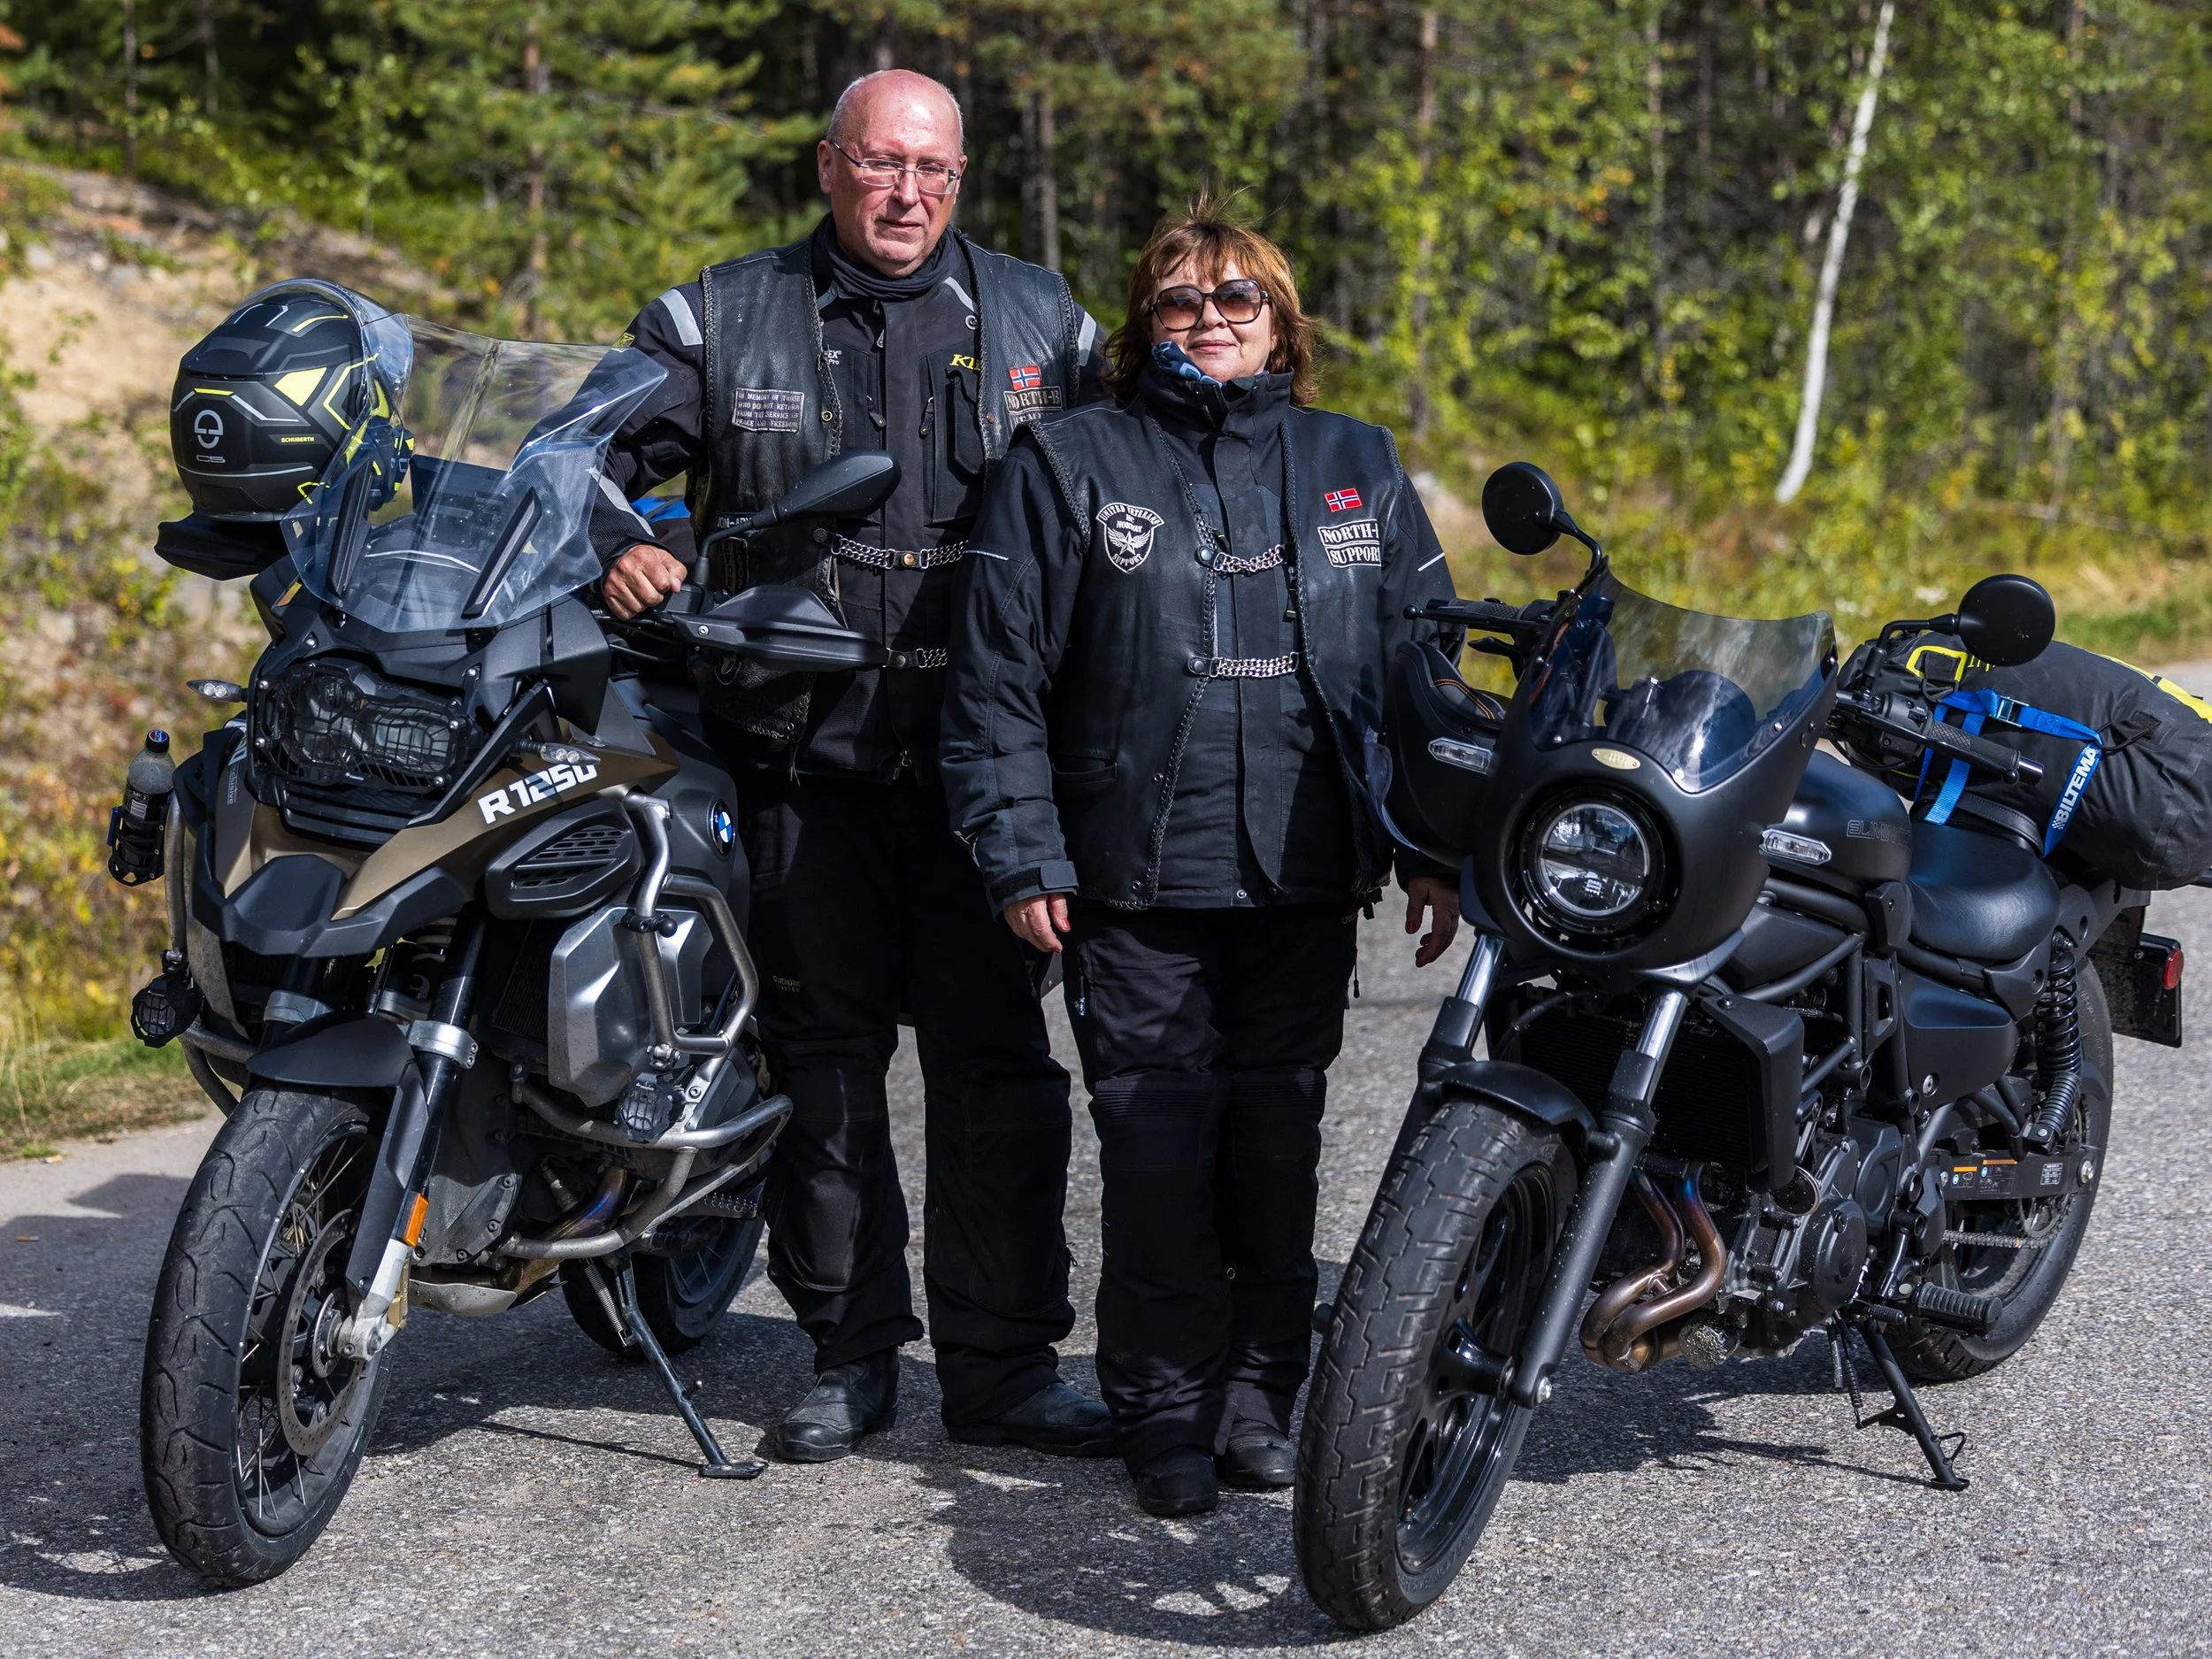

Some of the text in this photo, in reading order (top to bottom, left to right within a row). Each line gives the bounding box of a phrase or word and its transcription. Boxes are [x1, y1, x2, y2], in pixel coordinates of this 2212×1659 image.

[1099, 504, 1161, 526] UNITED VETERANS
[1116, 520, 1143, 533] NORWAY
[1320, 522, 1379, 543] NORTH-
[1112, 553, 1143, 566] SUPPORT
[2055, 747, 2099, 824] BILTEMA
